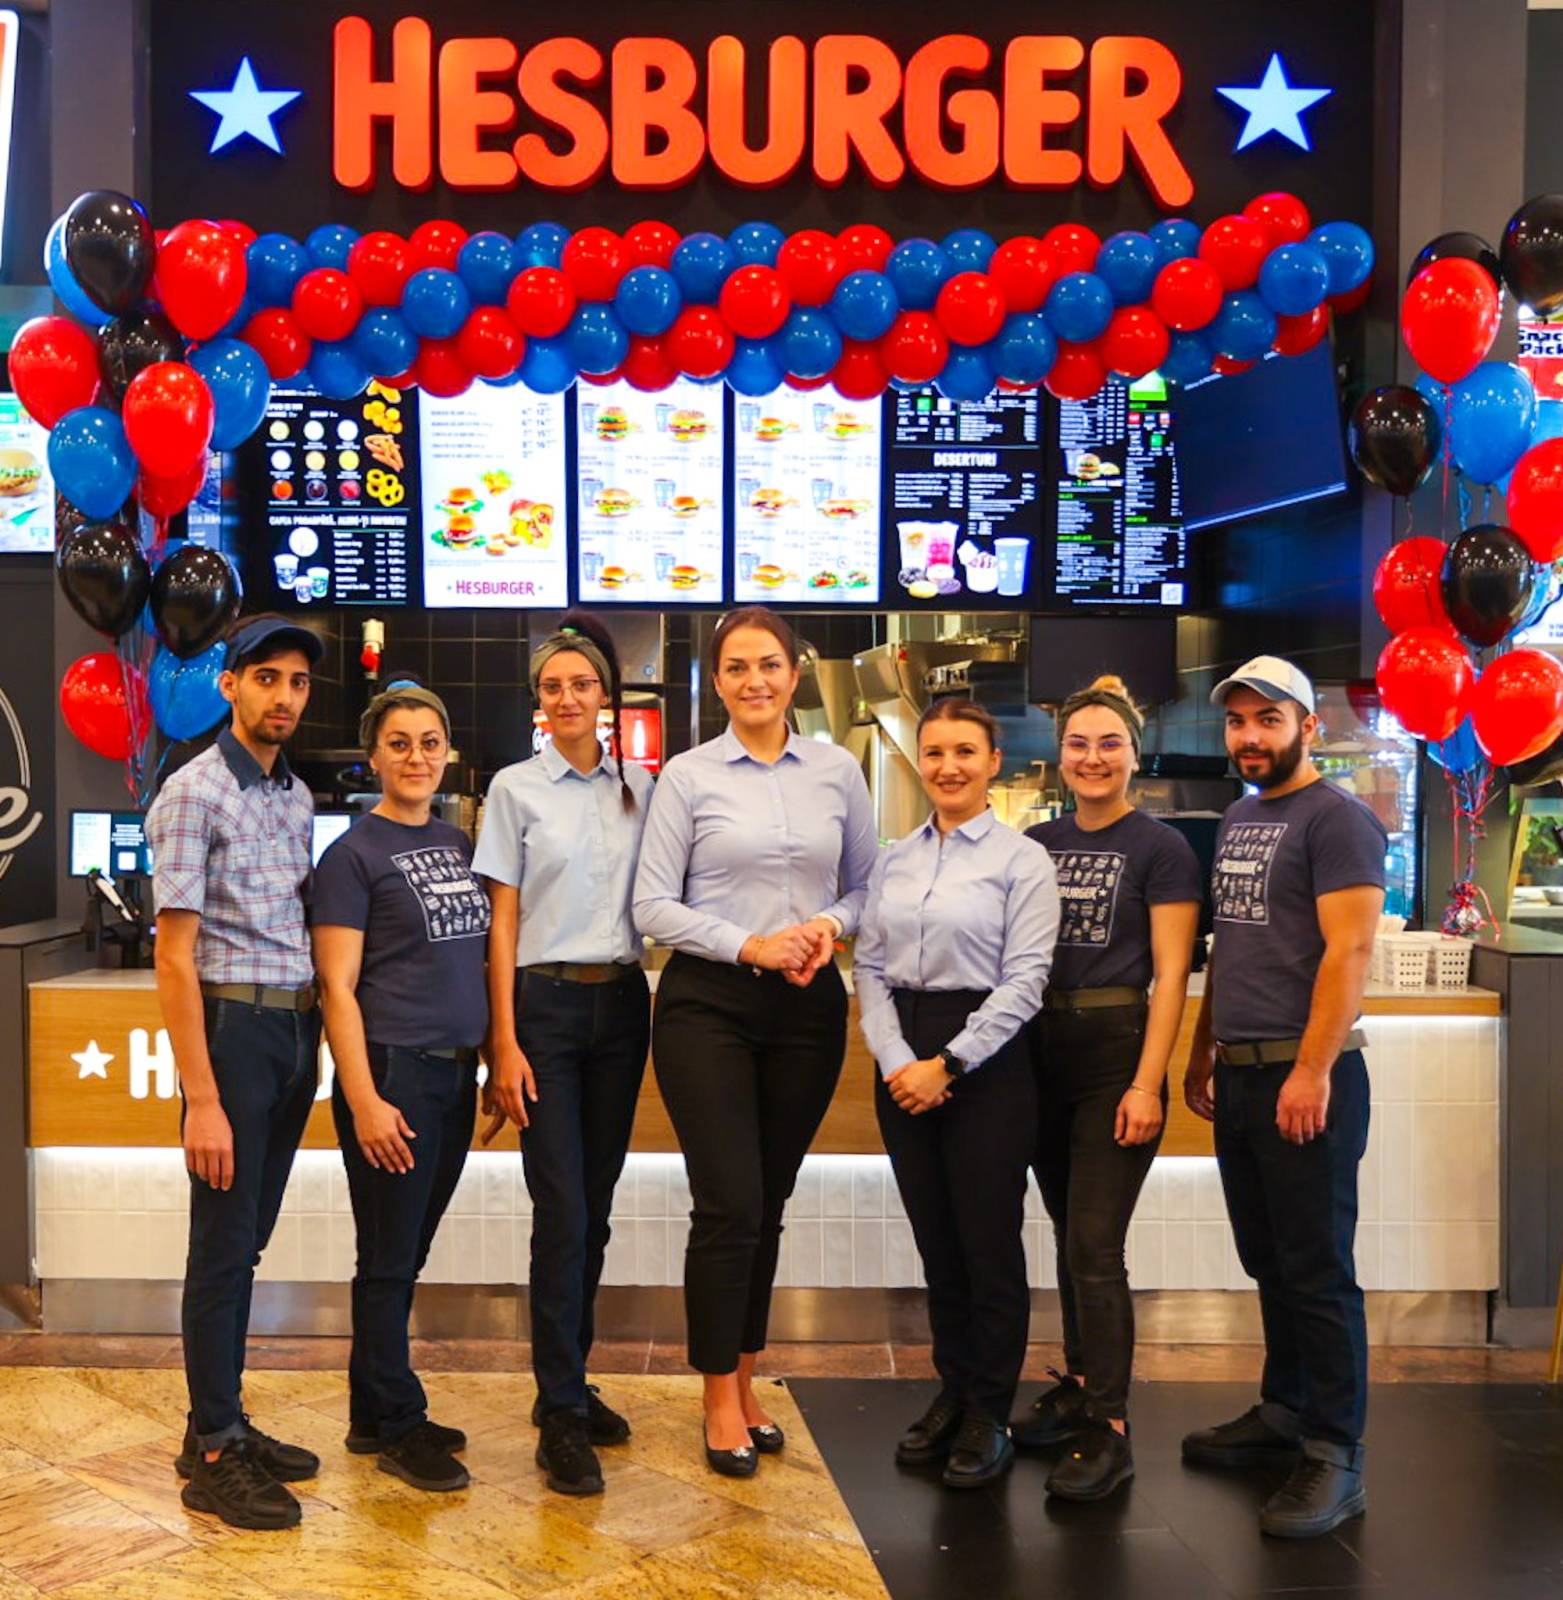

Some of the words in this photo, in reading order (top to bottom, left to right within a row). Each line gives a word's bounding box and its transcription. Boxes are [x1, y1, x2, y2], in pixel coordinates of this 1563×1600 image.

[333, 16, 1194, 207] HESBURGER
[1518, 329, 1563, 342] Snac
[934, 453, 997, 467] DESERTURI
[456, 580, 535, 597] HESBURGER
[1056, 886, 1097, 900] BURGER
